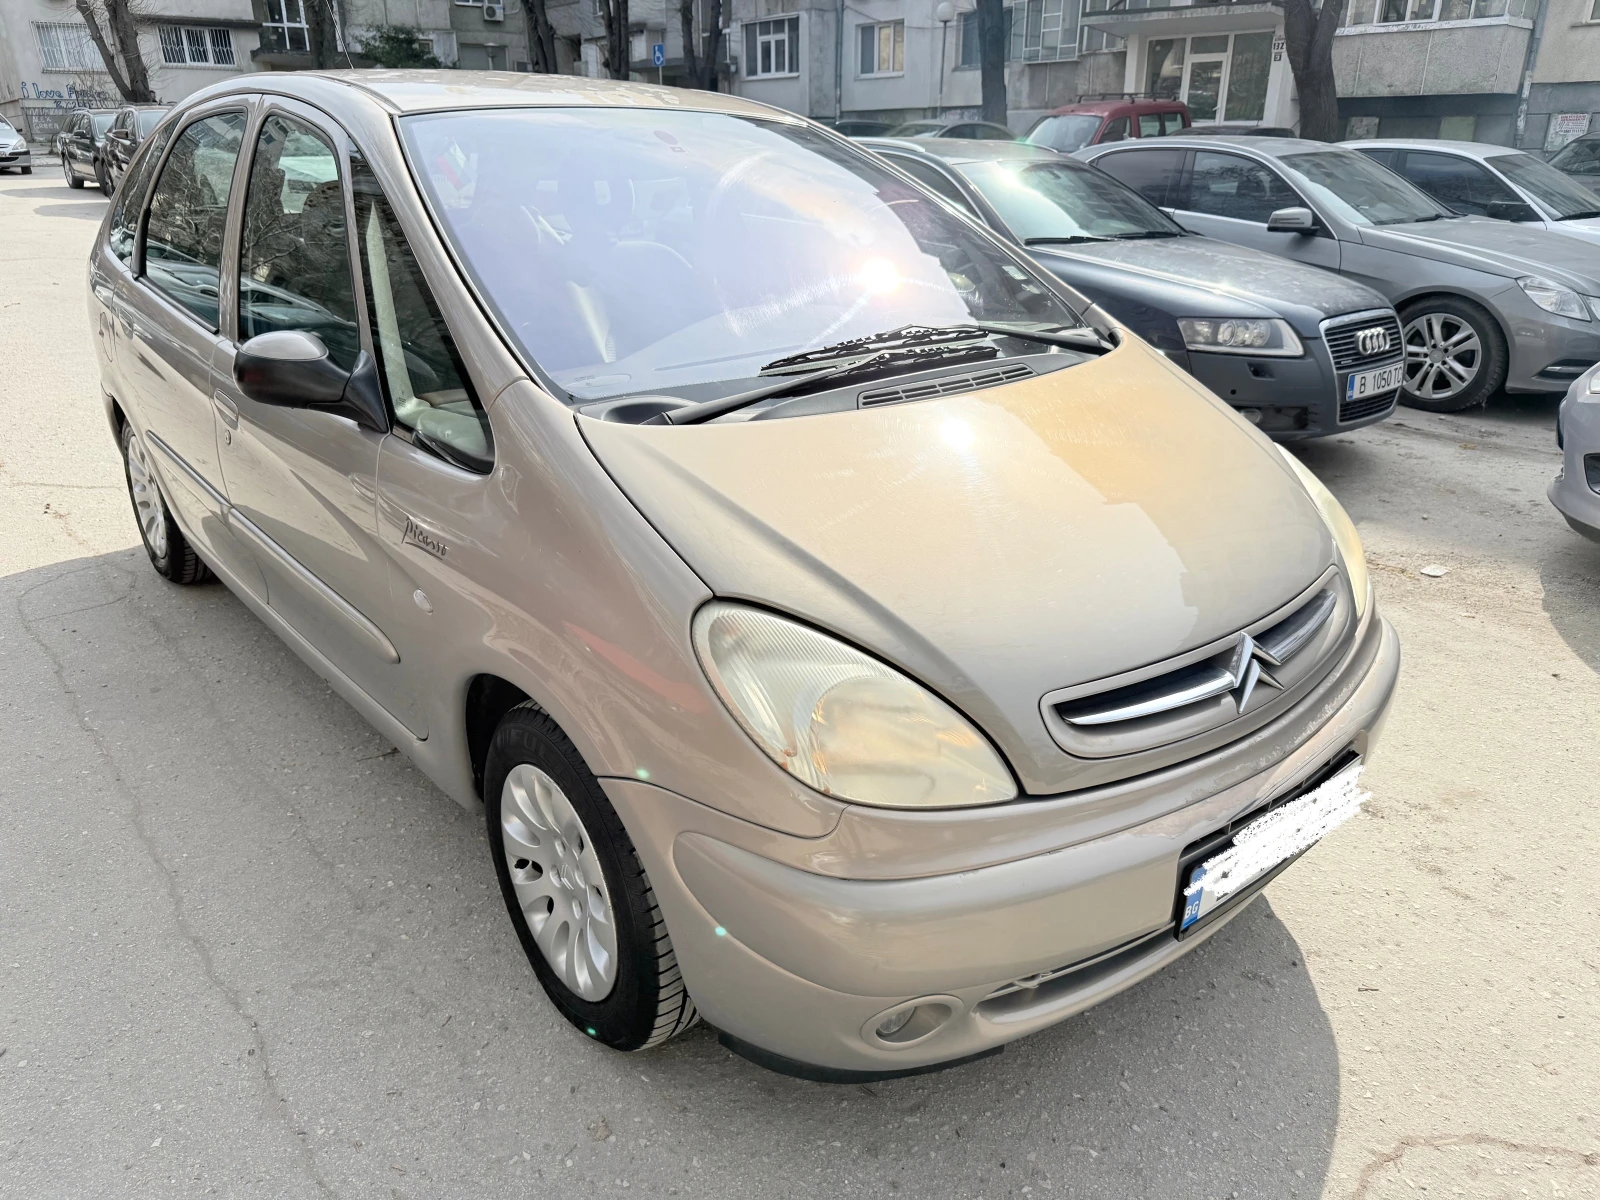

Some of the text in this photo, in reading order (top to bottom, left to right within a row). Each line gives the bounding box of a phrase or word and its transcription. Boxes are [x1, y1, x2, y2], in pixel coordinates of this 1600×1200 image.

[32, 82, 63, 99] love
[1359, 376, 1367, 395] B
[1372, 368, 1393, 392] 1050
[401, 516, 447, 556] Picasso
[1184, 901, 1200, 919] BG
